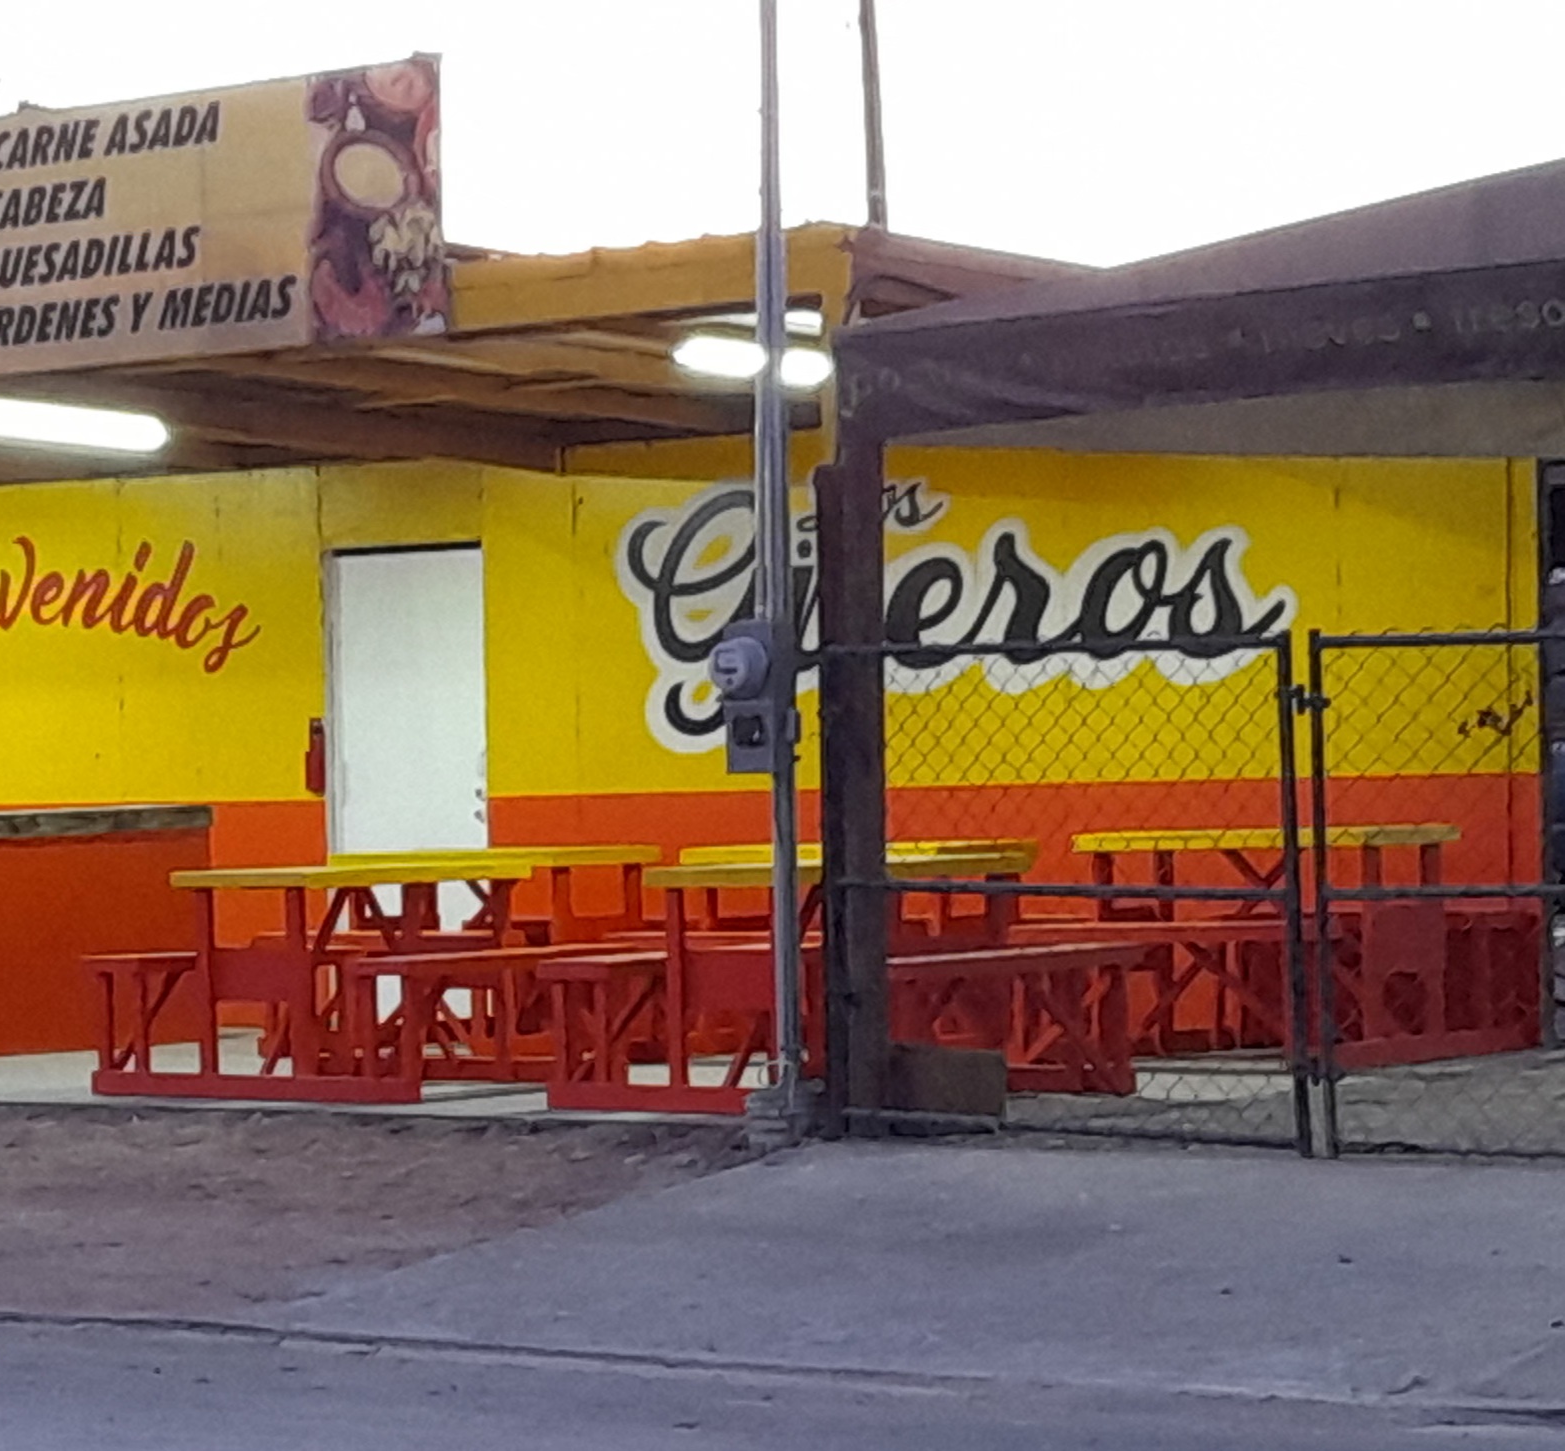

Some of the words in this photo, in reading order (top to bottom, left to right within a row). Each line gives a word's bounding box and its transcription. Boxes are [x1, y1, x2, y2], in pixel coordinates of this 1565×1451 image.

[106, 101, 220, 155] ASADA
[130, 292, 151, 334] Y
[158, 276, 298, 330] MEDIAS
